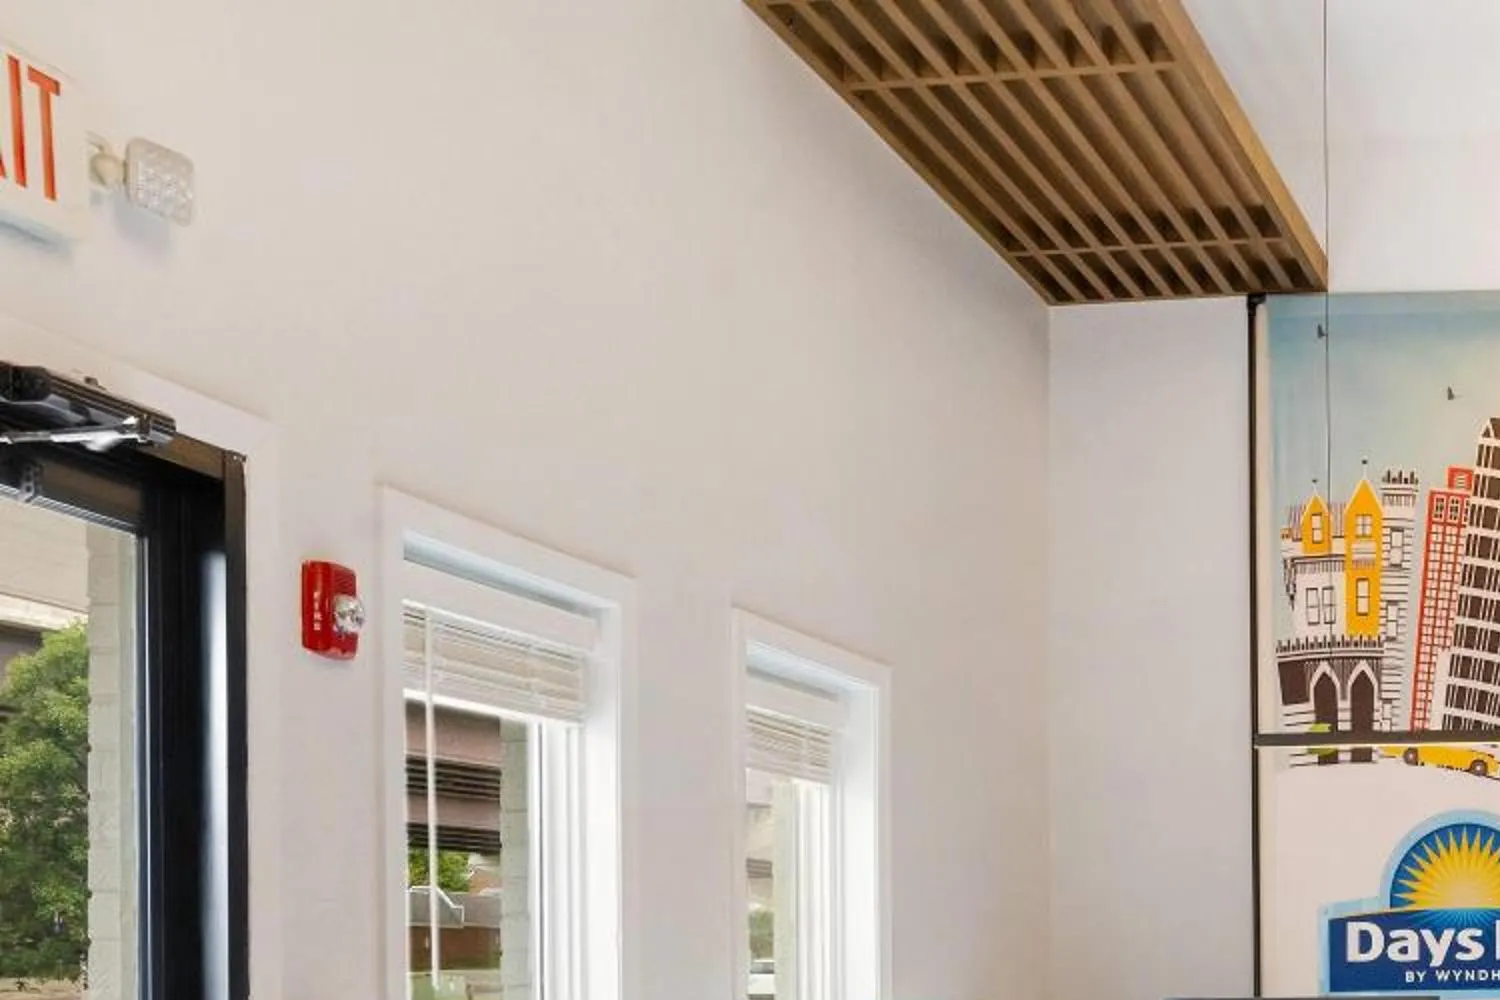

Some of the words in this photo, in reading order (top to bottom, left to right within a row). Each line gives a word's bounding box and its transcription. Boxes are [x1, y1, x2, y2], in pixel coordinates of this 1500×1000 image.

[0, 54, 61, 202] IT
[1346, 921, 1485, 967] Days
[1405, 971, 1425, 983] BY
